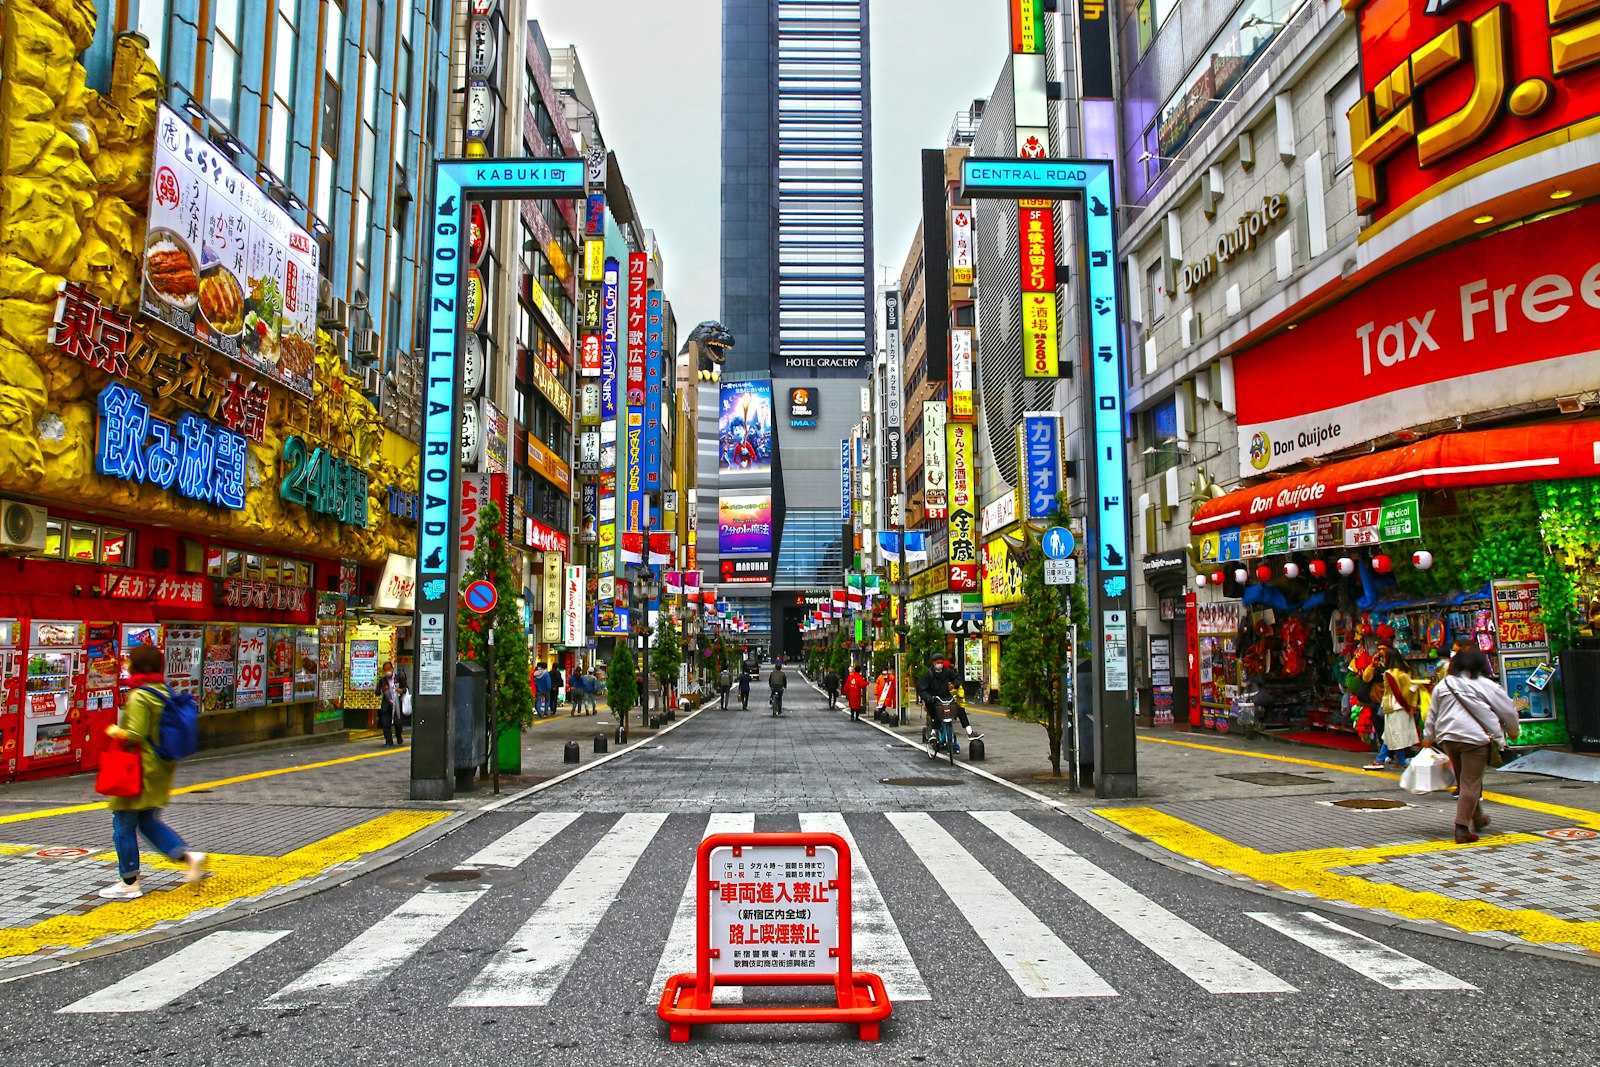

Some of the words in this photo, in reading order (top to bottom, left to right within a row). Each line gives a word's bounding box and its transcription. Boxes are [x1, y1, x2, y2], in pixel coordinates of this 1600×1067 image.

[472, 66, 486, 75] 6F
[972, 168, 1042, 180] CENTRAL
[1046, 170, 1088, 181] ROAD
[186, 178, 200, 244] うな丼
[1029, 210, 1042, 219] 5F
[233, 215, 247, 274] かつ丼
[957, 238, 968, 267] 鳥メロ
[1182, 254, 1215, 293] Don
[1214, 192, 1288, 266] Quijote
[429, 223, 458, 417] GODZILLA
[628, 258, 646, 384] カラオケ歌広場
[886, 297, 897, 325] Booth
[1031, 306, 1049, 332] 酒場
[1034, 338, 1047, 370] 280
[1355, 308, 1441, 377] Tax
[602, 351, 615, 402] SHINJUKU
[785, 358, 816, 367] HOTEL
[816, 358, 860, 368] GRACERY
[1091, 248, 1120, 512] ゴジラロード
[791, 419, 817, 427] IMAX
[98, 381, 249, 513] 飲み放題
[888, 431, 899, 460] Booth
[1272, 438, 1296, 457] Don
[1297, 422, 1342, 452] Quijote
[953, 427, 967, 492] きんくら酒場
[1030, 421, 1056, 514] カラオケ
[424, 440, 449, 536] ROAD
[1250, 496, 1274, 515] Don
[1275, 481, 1326, 510] Quijote
[459, 480, 477, 551] トラノコ
[928, 509, 943, 518] B1
[949, 506, 976, 562] 金の蔵
[735, 561, 769, 572] MARUHAN
[951, 566, 968, 581] 2F
[104, 573, 203, 603] 東京カラオケ本舗
[546, 611, 558, 624] 集
[204, 676, 229, 689] 2,000
[719, 881, 829, 904] 車両進入禁止
[737, 908, 812, 921] (新宿区内全域)
[728, 923, 821, 945] 路上喫煙禁止
[733, 950, 816, 959] 新宿警察署・新宿区
[733, 959, 816, 969] 歌舞伎町商店街振興組合
